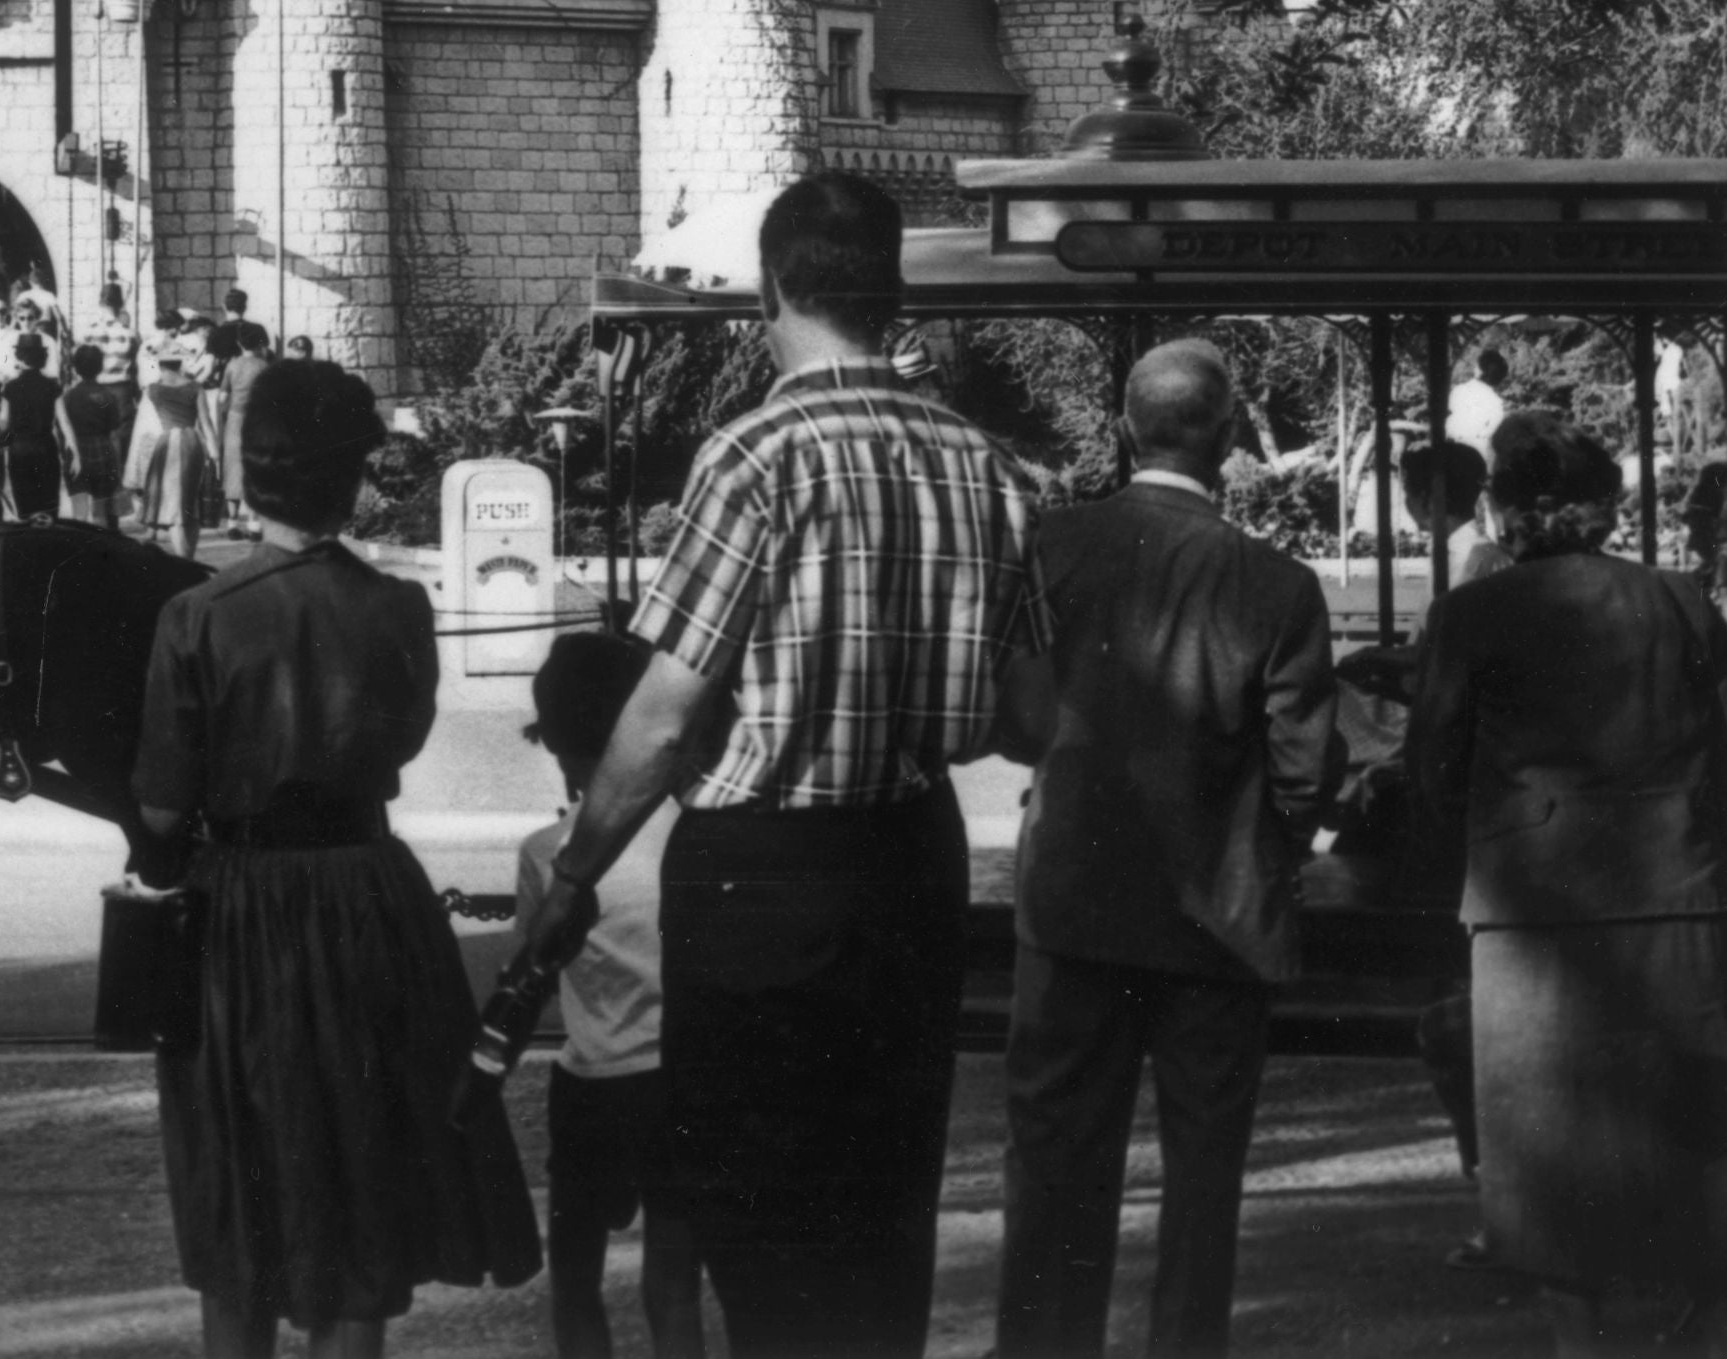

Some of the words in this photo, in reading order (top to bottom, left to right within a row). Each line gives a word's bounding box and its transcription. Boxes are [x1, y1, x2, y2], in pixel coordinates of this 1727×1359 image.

[1161, 231, 1328, 259] DEPOT
[1390, 231, 1521, 259] MAIN
[476, 502, 530, 520] PUSH
